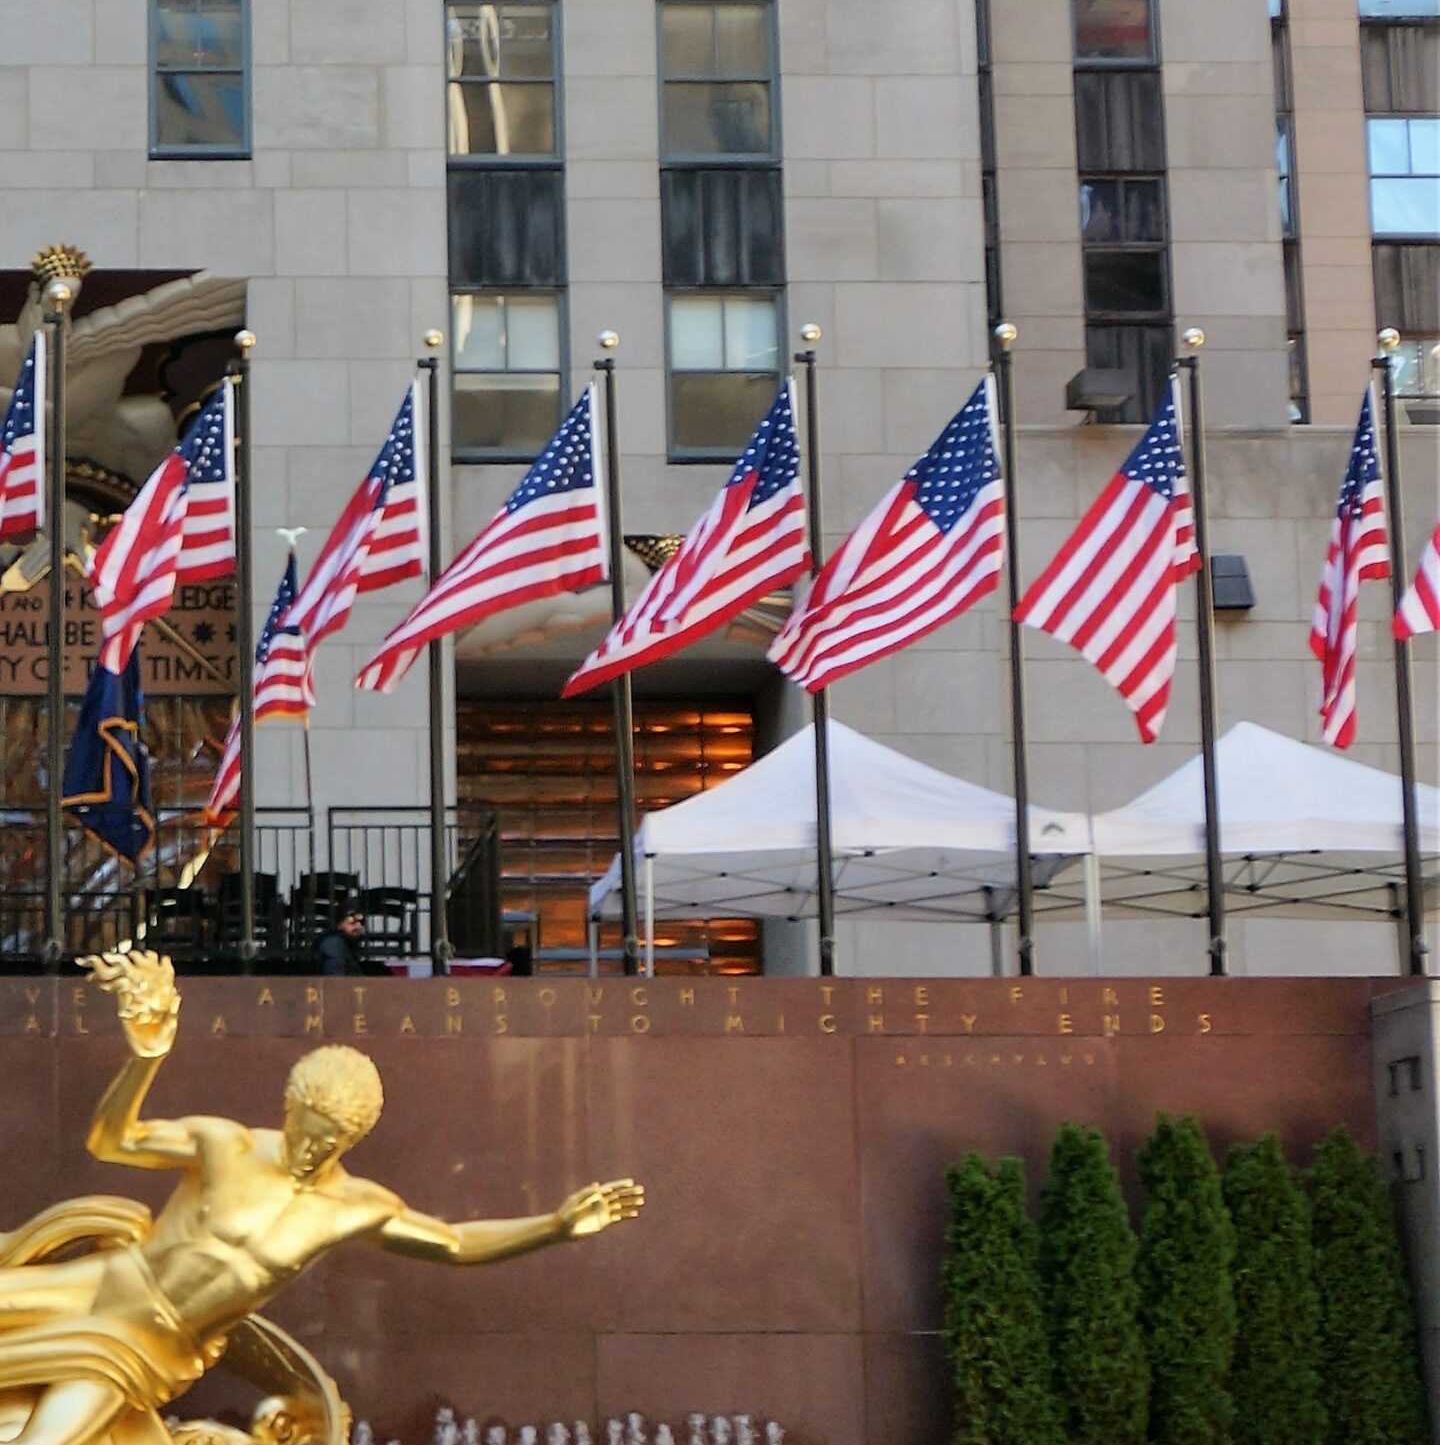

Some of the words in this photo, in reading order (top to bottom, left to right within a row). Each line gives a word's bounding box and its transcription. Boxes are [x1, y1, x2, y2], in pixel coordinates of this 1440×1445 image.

[65, 620, 95, 646] BE
[259, 987, 367, 1006] ART
[821, 986, 930, 1006] THE
[1011, 986, 1166, 1006] FIRE
[212, 1015, 228, 1034] A
[304, 1015, 509, 1035] MEANS
[588, 1015, 651, 1034] TO
[723, 1014, 978, 1034] MIGHTY
[1059, 1013, 1211, 1034] ENDS
